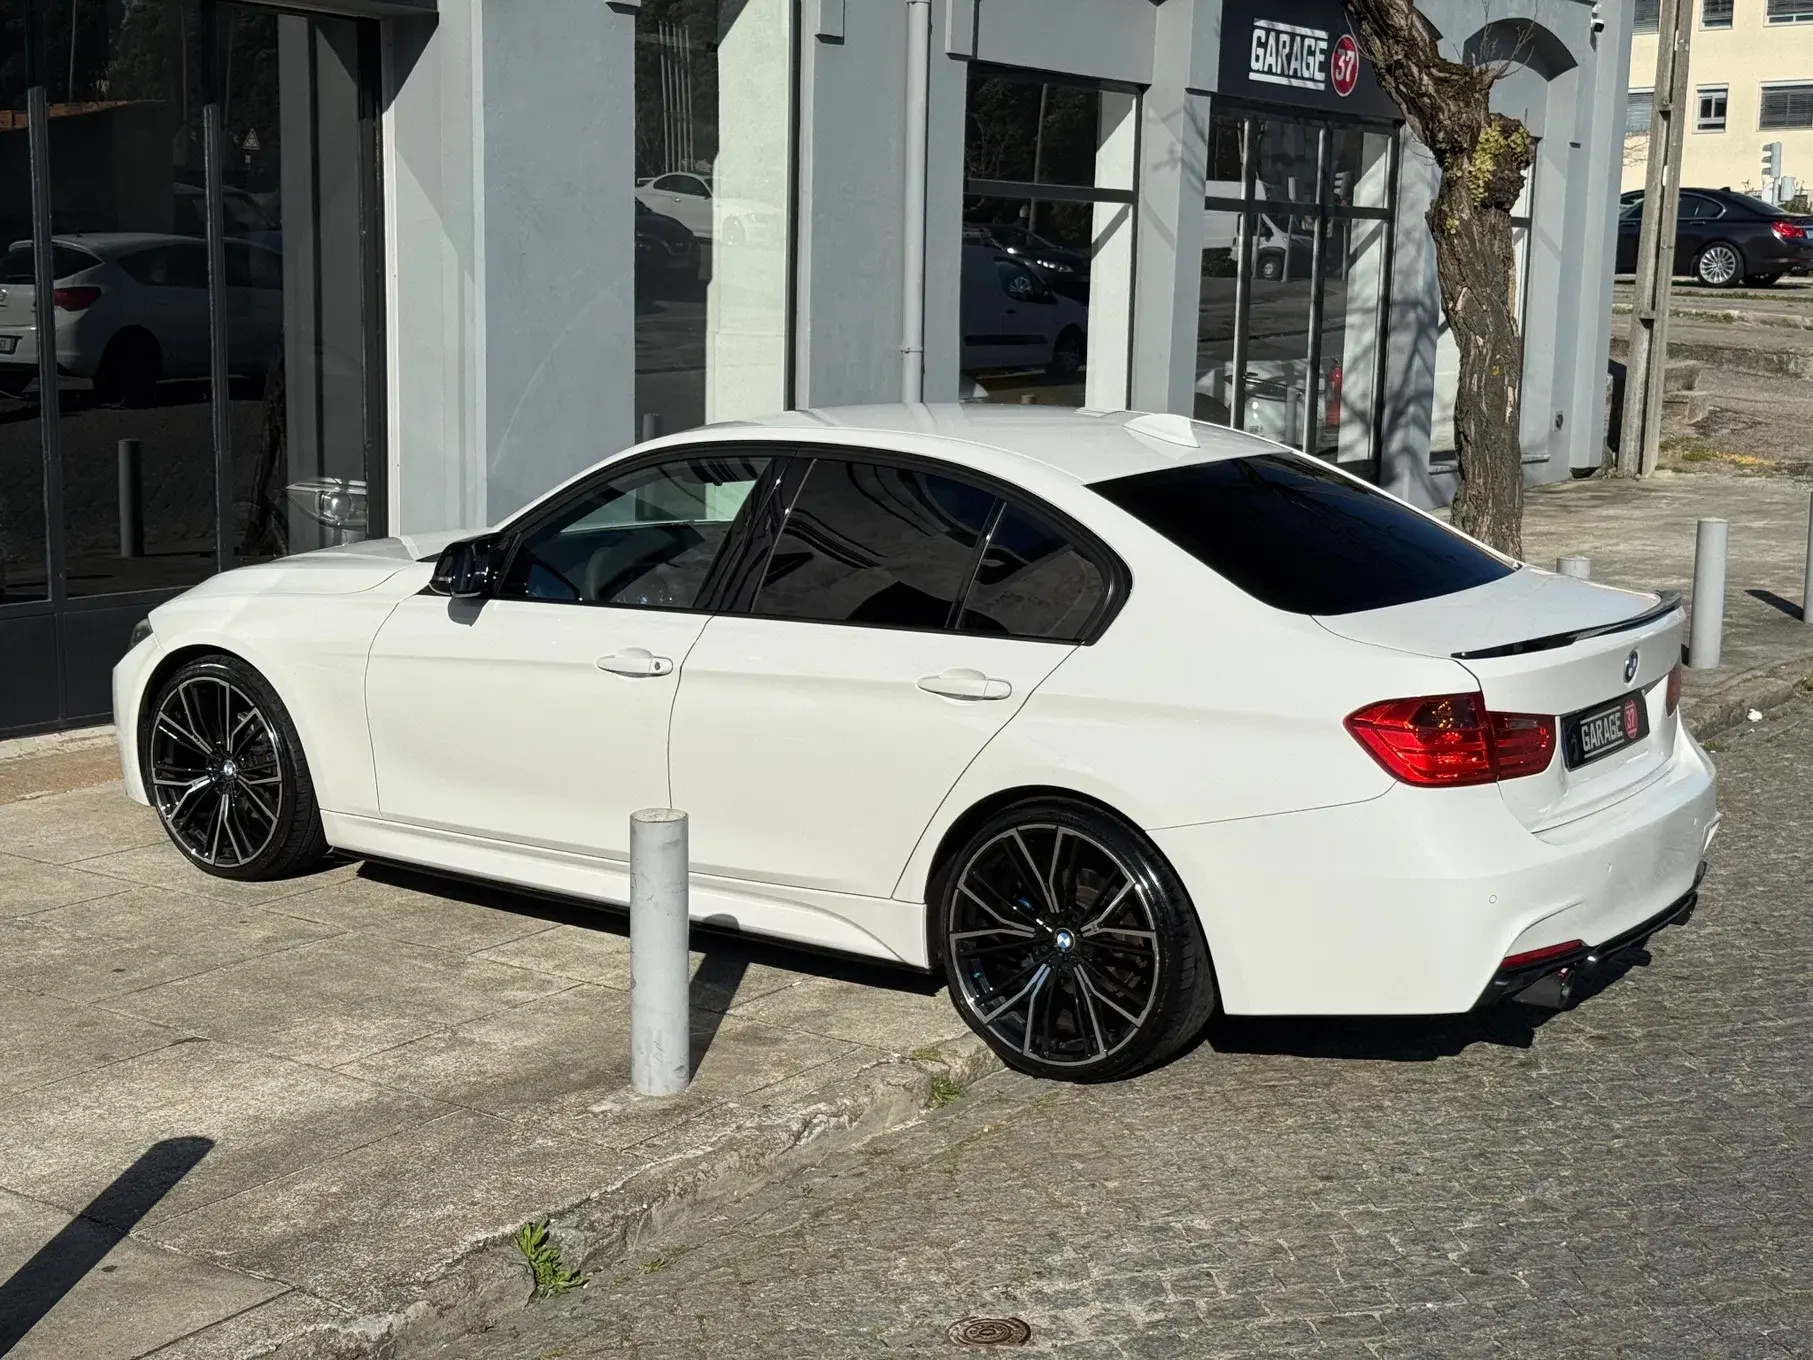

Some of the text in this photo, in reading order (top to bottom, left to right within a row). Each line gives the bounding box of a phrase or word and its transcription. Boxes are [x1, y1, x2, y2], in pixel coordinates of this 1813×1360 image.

[1250, 28, 1355, 82] GARAGE 37
[1581, 708, 1635, 752] GARAGE 37
